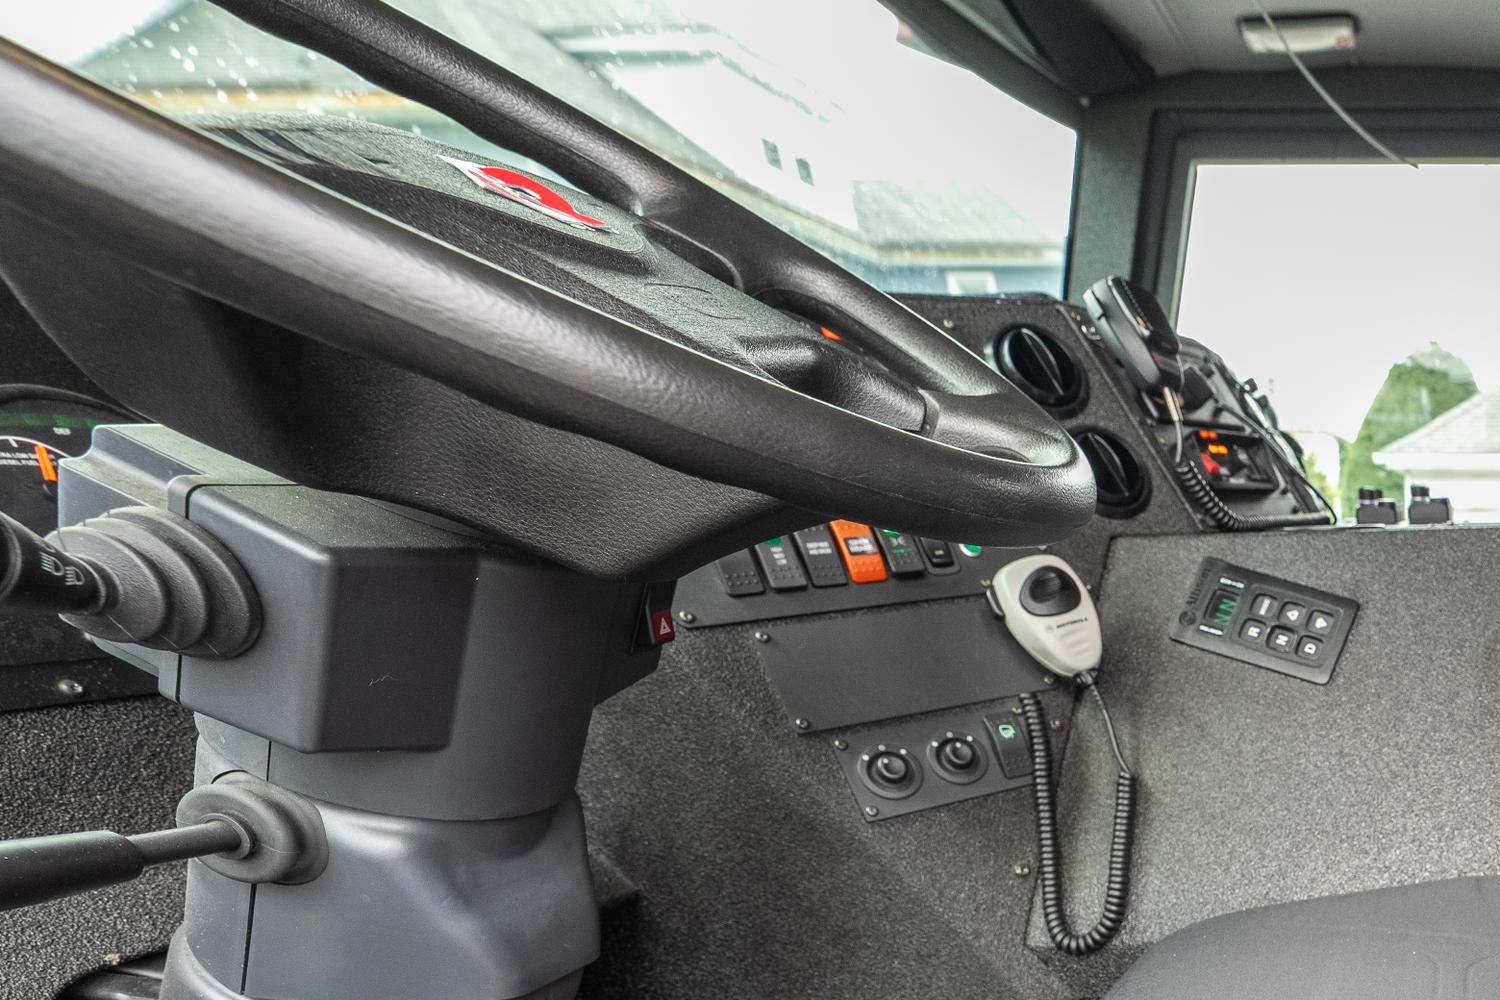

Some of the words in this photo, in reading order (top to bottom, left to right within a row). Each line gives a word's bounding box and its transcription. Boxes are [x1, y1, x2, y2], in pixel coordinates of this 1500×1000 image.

[1247, 626, 1261, 639] R
[1275, 634, 1289, 646] N
[1303, 642, 1316, 655] D
